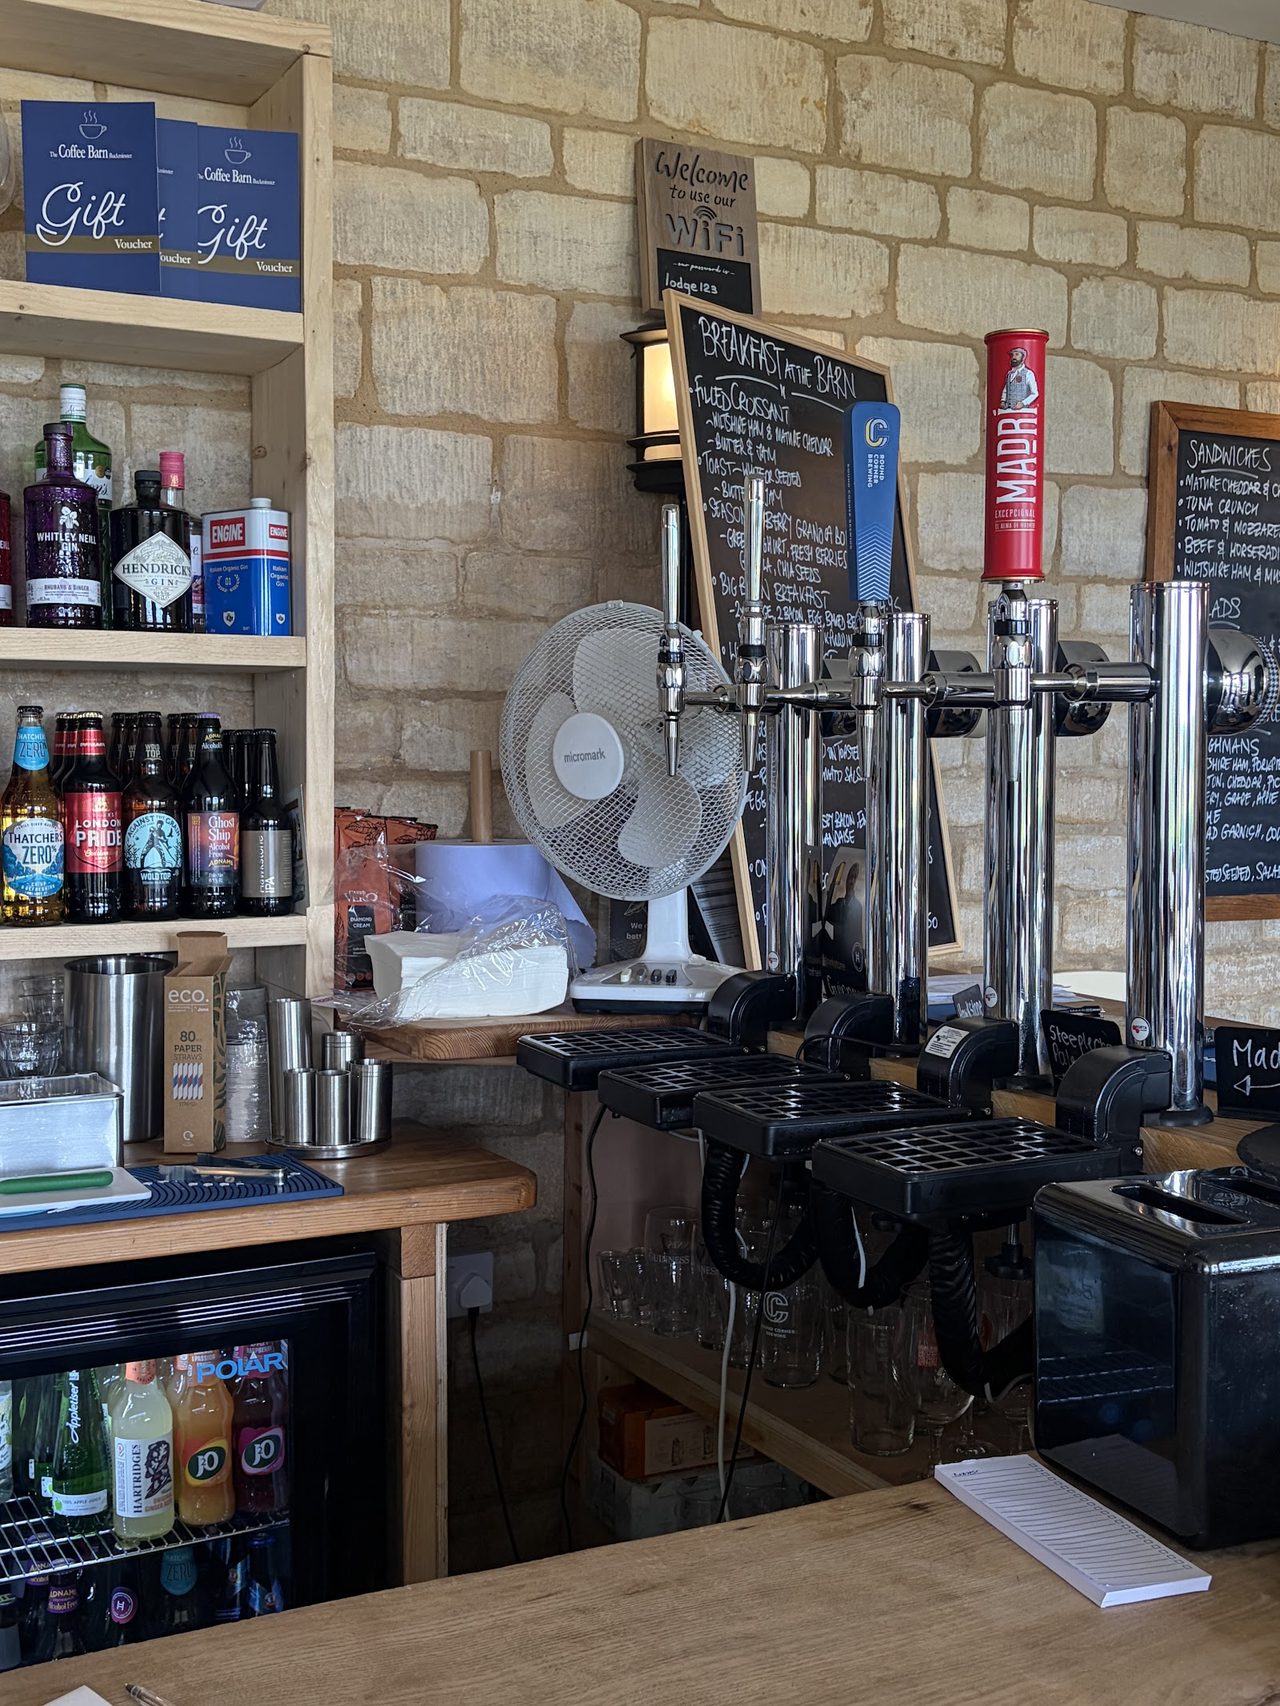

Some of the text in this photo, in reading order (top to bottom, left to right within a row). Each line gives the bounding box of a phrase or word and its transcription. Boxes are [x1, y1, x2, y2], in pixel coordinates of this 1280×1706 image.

[58, 144, 86, 159] Coffee
[87, 145, 108, 159] Barn
[204, 167, 252, 184] Coffee Barn
[656, 151, 748, 193] Welcome
[669, 184, 736, 208] to use our
[36, 181, 126, 247] Gift
[114, 238, 152, 249] Voucher
[198, 203, 268, 265] Gift
[666, 213, 744, 257] WiFi
[256, 261, 293, 273] Voucher
[665, 272, 719, 295] lodge123
[699, 316, 786, 380] BREAKFAST
[814, 355, 857, 400] BARN
[694, 375, 790, 425] FILLED CROISSANT
[748, 419, 764, 439] HAM
[715, 432, 747, 456] BUTTER
[702, 450, 736, 477] TOAST
[1187, 439, 1272, 473] SANDWICHES
[1185, 473, 1222, 493] MATURE
[1222, 478, 1262, 496] CHEDDAR
[995, 509, 1035, 519] EXCEPCIONAL
[1185, 496, 1260, 516] TUNA CRUNCH
[270, 526, 288, 538] ENGINE
[1184, 514, 1220, 532] TOMATO
[36, 531, 97, 545] WHITLEY NEILL
[212, 523, 244, 544] ENGINE
[726, 527, 745, 549] GREE
[61, 542, 79, 552] GIN
[1184, 536, 1217, 555] BEEF
[795, 564, 822, 584] SEEDS
[1183, 557, 1230, 579] WILTSHIRE
[1231, 563, 1252, 583] HAM
[151, 578, 174, 586] GIN
[719, 571, 831, 610] BIG BREAKFAST
[563, 747, 607, 763] micromark
[1208, 737, 1261, 757] GHMANS
[75, 819, 121, 828] LONDON
[128, 815, 155, 837] AGAINST
[8, 831, 63, 844] THATCHERS
[75, 830, 122, 848] PRIDE
[208, 828, 231, 844] Ship
[140, 872, 159, 881] WOLD
[265, 876, 275, 893] IPA
[168, 989, 209, 1003] eco.
[179, 1031, 196, 1042] 80
[173, 1053, 203, 1061] STRAWS
[174, 1044, 202, 1053] PAPER
[196, 1352, 285, 1384] POLAR
[66, 1382, 81, 1444] Appletiser
[132, 1444, 143, 1514] HARTRIDGES
